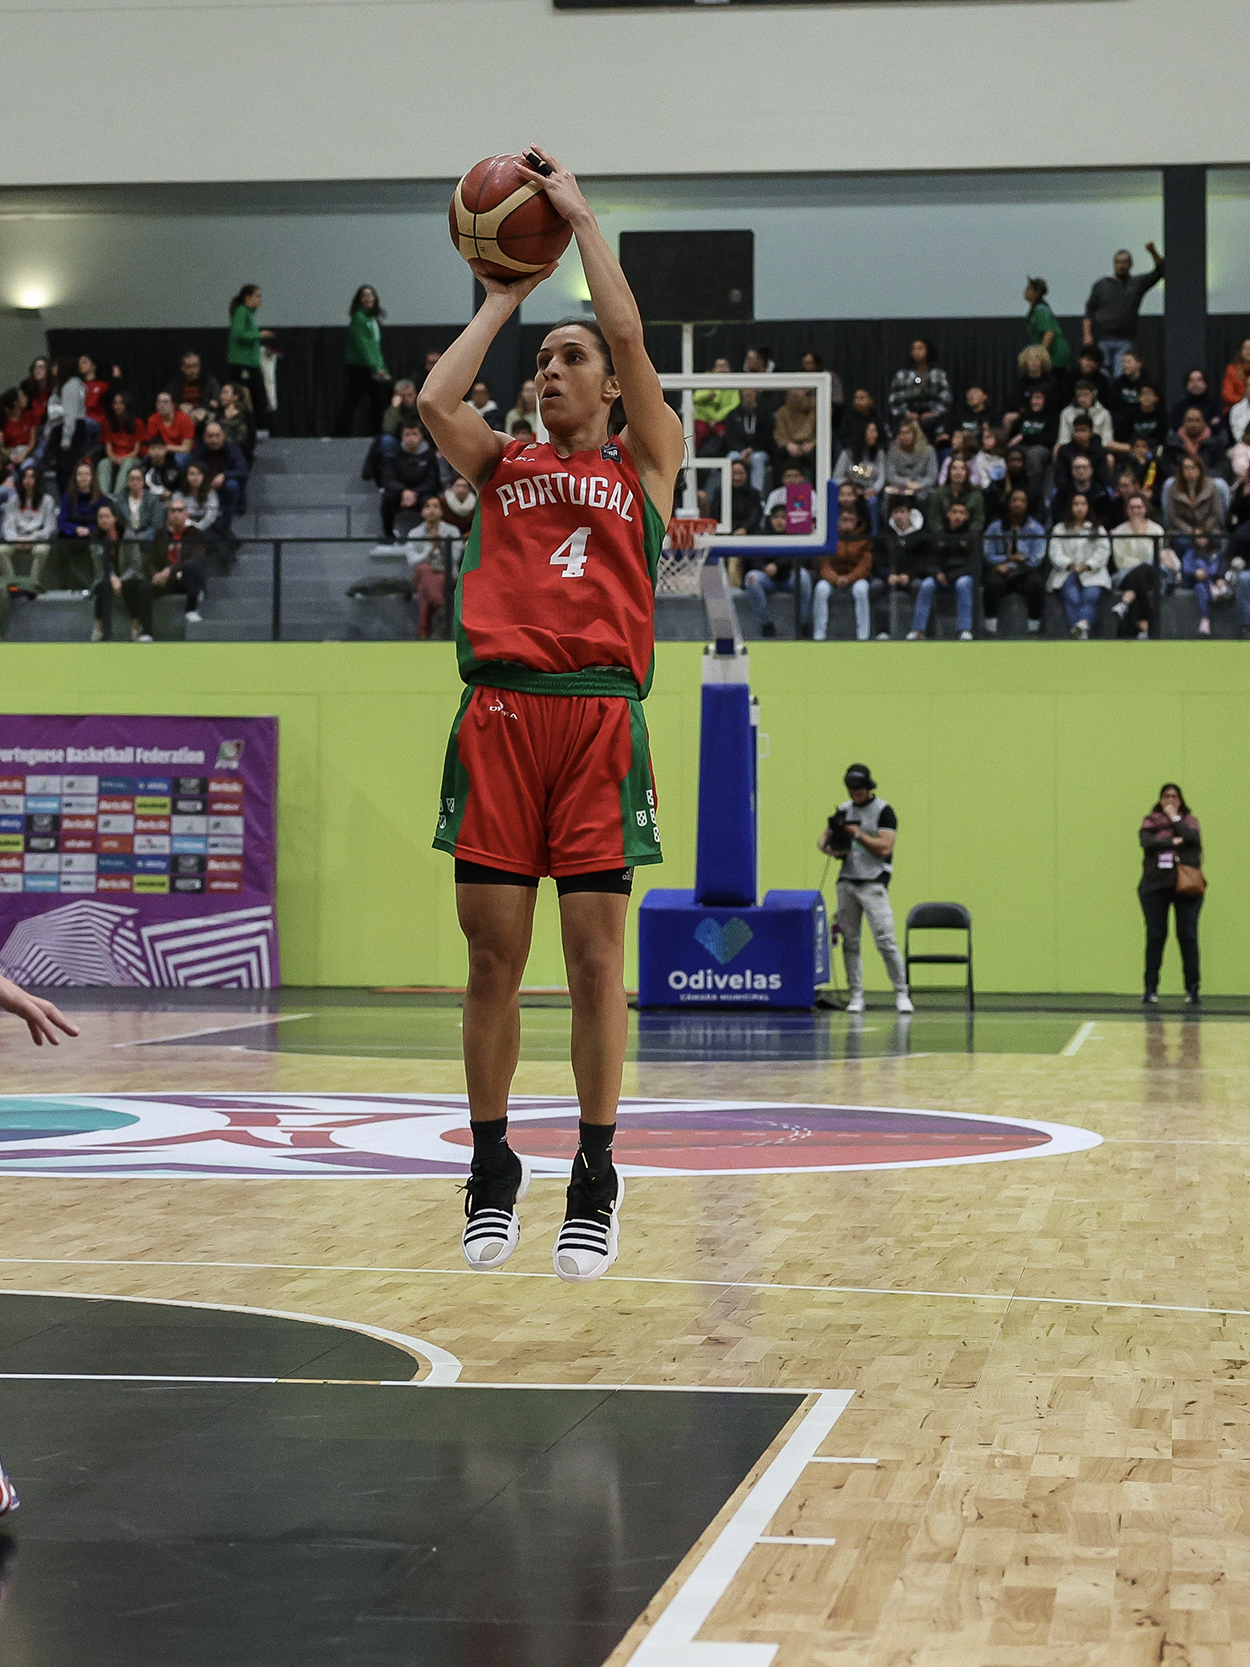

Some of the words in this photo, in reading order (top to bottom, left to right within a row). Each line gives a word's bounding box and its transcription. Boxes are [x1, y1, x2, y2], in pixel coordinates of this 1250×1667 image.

[496, 472, 634, 522] PORTUGAL
[549, 527, 592, 578] 4
[668, 968, 782, 990] Odivelas
